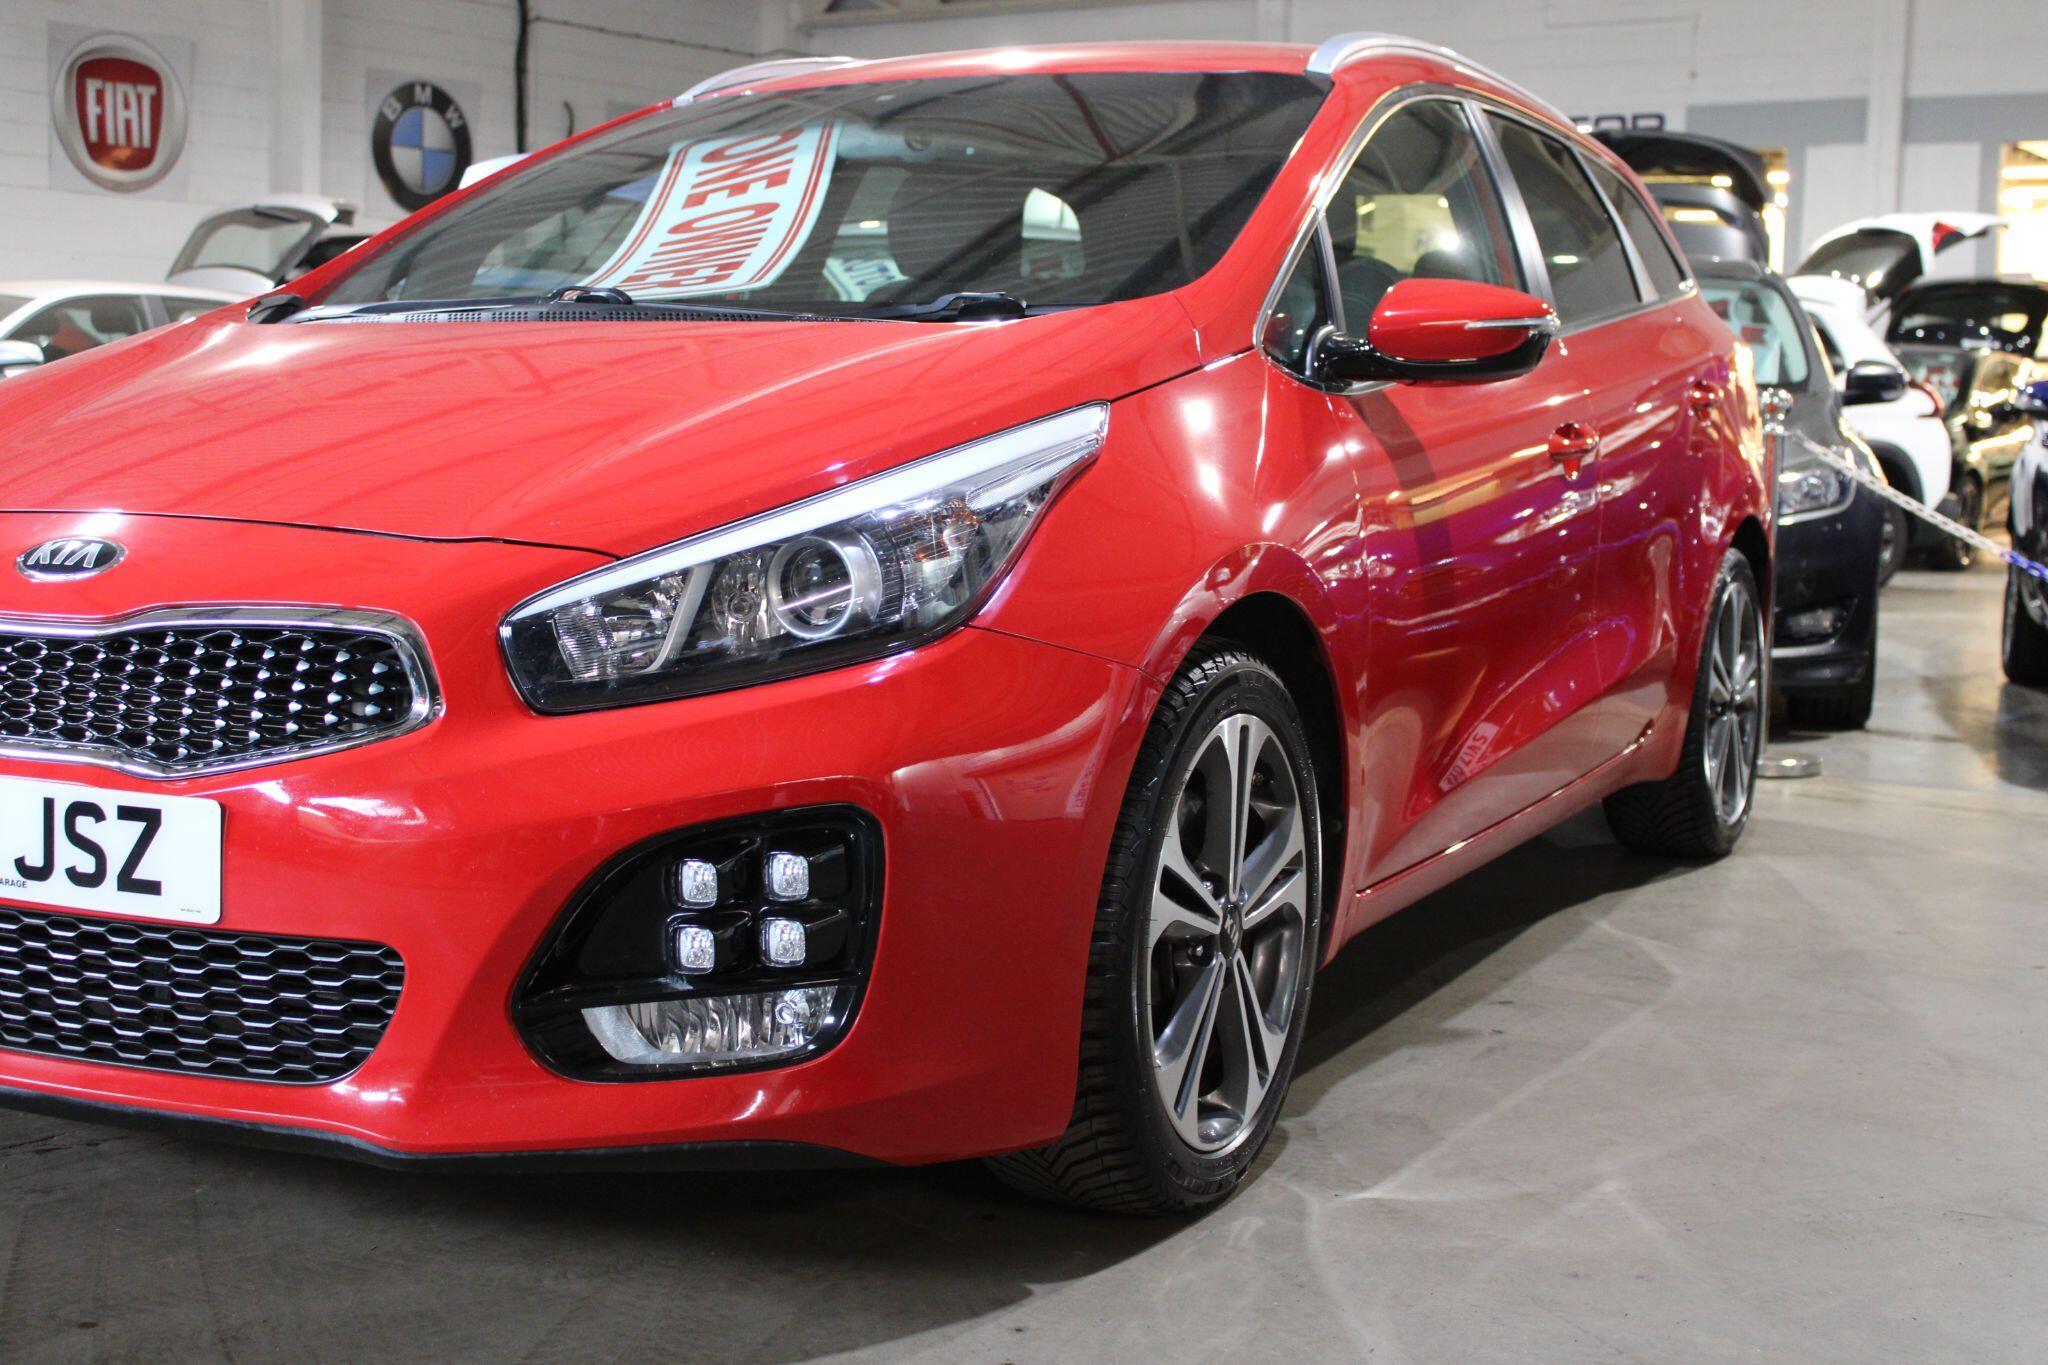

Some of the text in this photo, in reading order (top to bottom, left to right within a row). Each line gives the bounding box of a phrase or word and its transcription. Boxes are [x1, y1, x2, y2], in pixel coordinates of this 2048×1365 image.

[85, 78, 157, 149] FIAT
[382, 82, 464, 128] BMW
[612, 127, 804, 292] ONE OWNER
[26, 541, 104, 568] KIA
[14, 796, 162, 896] JSZ
